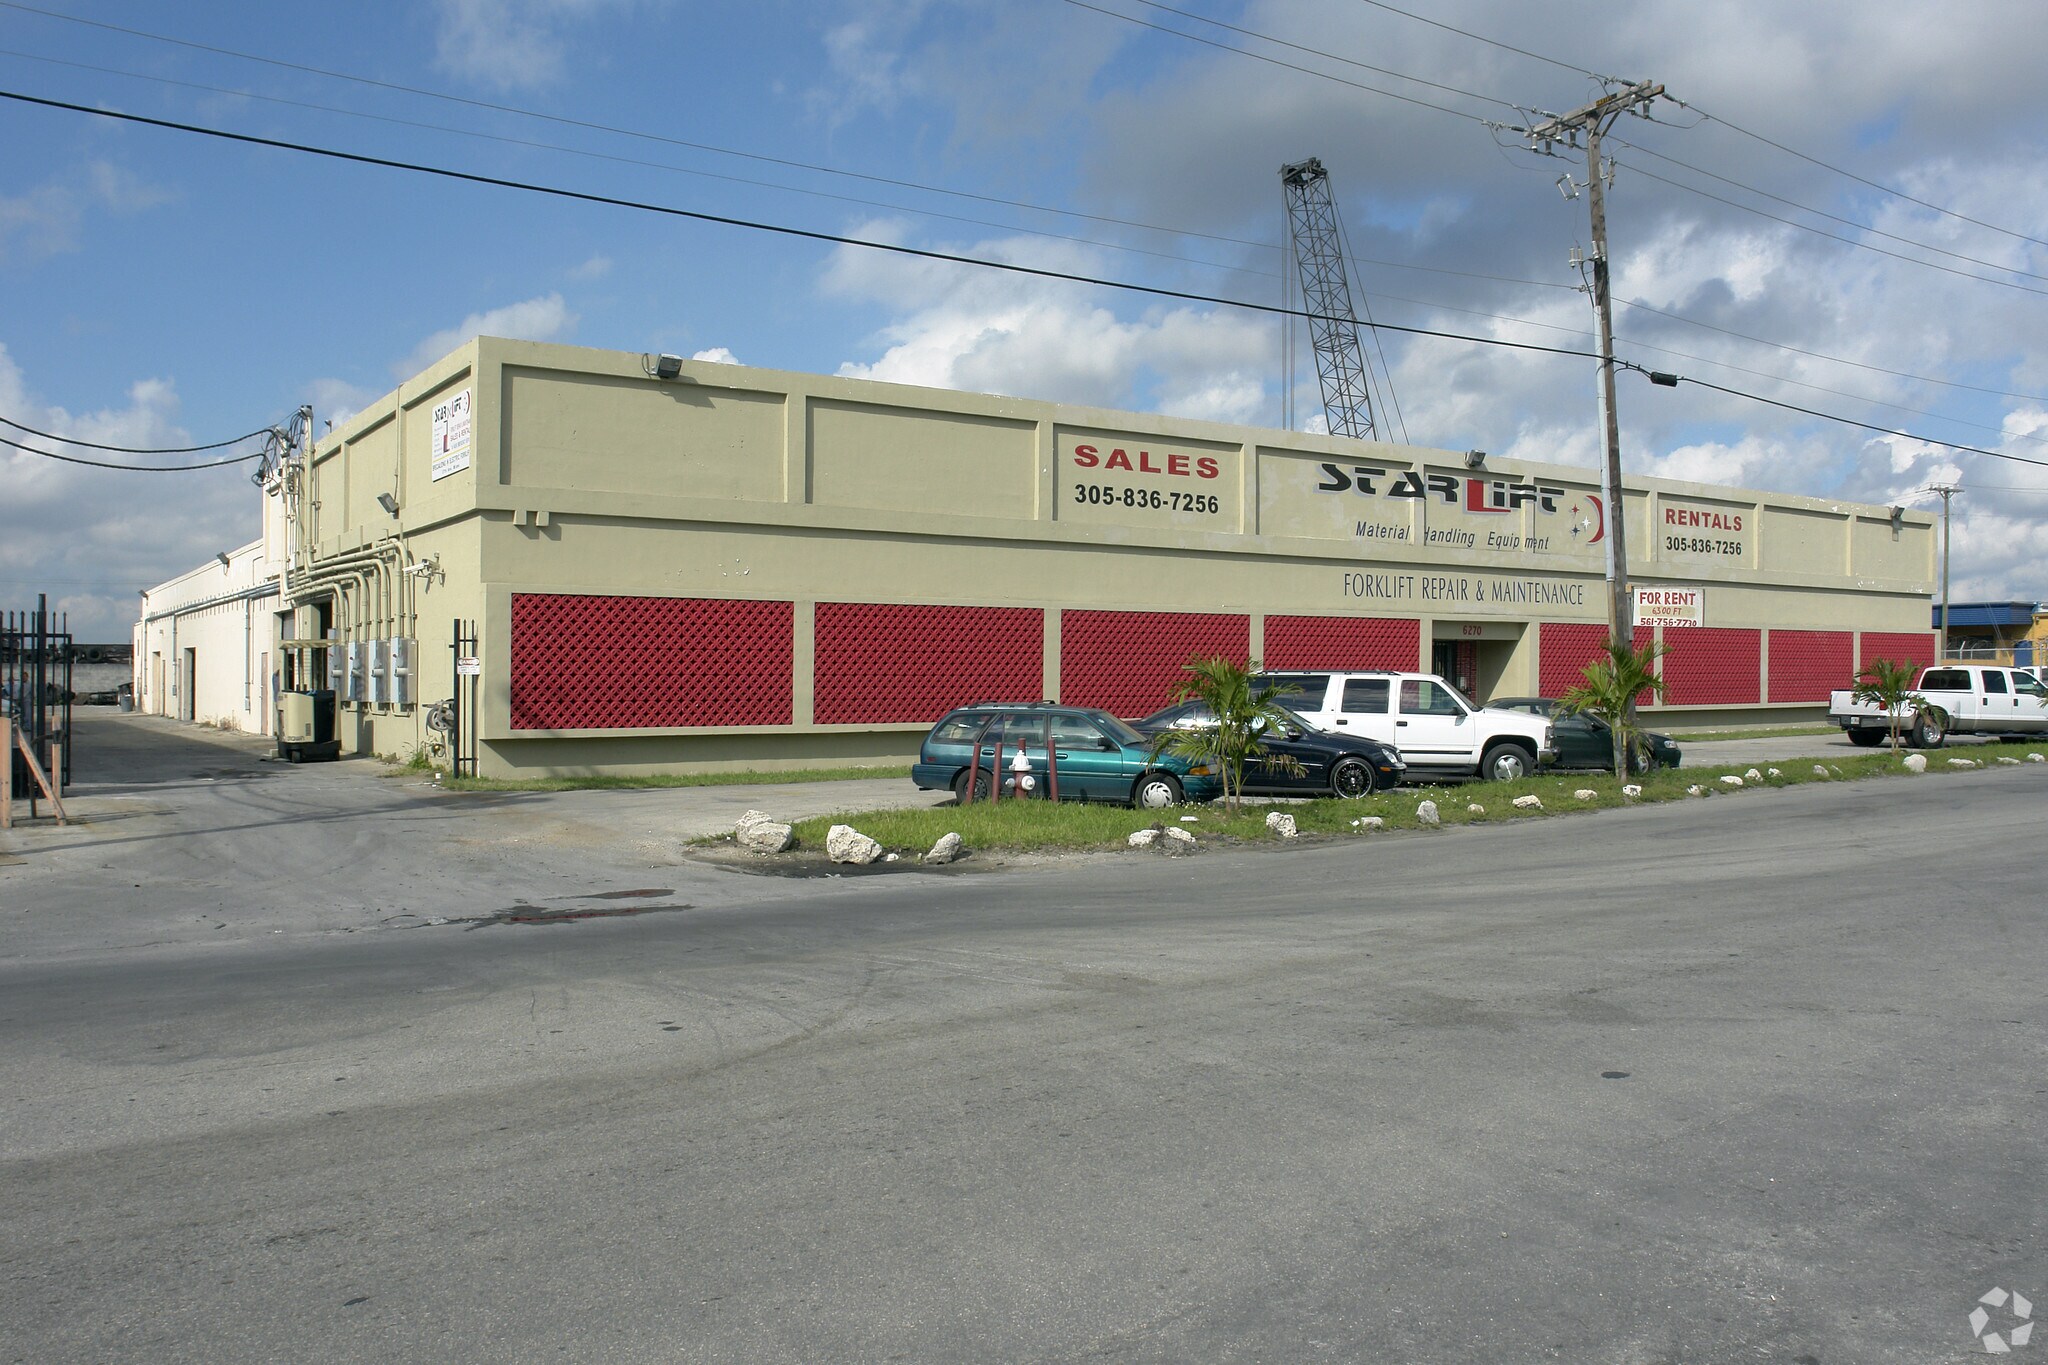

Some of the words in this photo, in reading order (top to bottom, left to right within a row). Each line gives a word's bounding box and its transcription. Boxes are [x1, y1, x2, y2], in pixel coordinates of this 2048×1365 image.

[1074, 444, 1219, 479] SALES
[1074, 484, 1219, 514] 305-836-7256
[1665, 508, 1742, 531] RENTALS
[1355, 521, 1411, 541] Material
[1666, 536, 1742, 555] 305-836-7256
[1344, 573, 1414, 599] FORKLIFT
[1422, 577, 1468, 601] REPAIR
[1475, 580, 1484, 602] &
[1491, 580, 1583, 605] MAINTENANCE
[1639, 592, 1661, 605] FOR
[1664, 592, 1696, 606] RENT
[1673, 607, 1682, 616] FT
[1462, 625, 1482, 636] 6270
